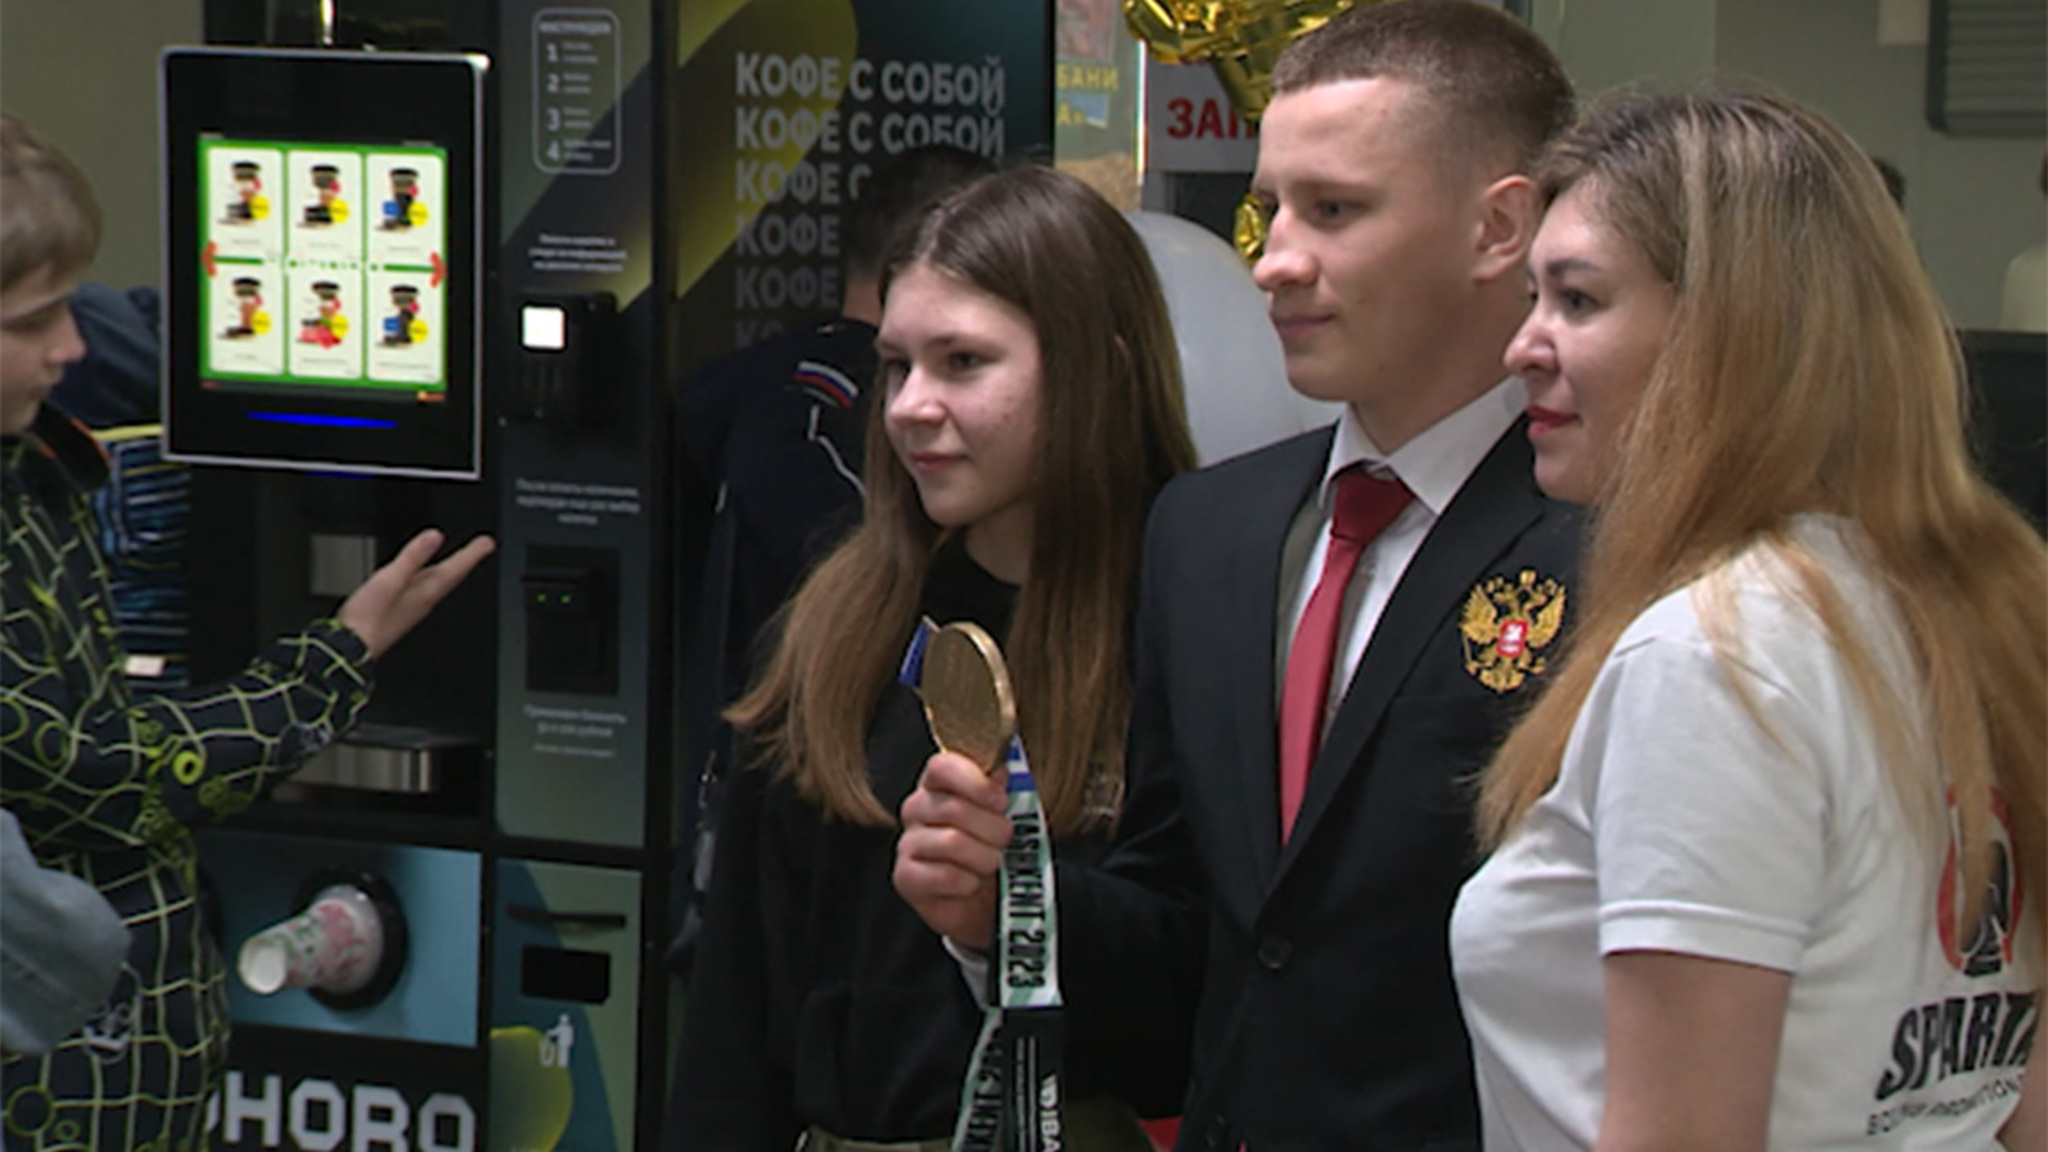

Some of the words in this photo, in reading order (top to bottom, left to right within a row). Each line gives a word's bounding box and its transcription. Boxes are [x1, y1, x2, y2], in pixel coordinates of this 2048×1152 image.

[547, 43, 559, 62] 1
[547, 73, 560, 93] 2
[735, 52, 841, 98] КОФЕ
[849, 58, 873, 101] С
[881, 55, 1005, 105] СОБОЙ
[547, 108, 560, 131] 3
[735, 106, 841, 153] КОФЕ
[849, 111, 873, 152] С
[547, 139, 560, 162] 4
[735, 158, 841, 205] КОФЕ
[735, 212, 841, 257] КОФЕ
[735, 265, 840, 309] КОФЕ
[1007, 928, 1046, 989] 2023
